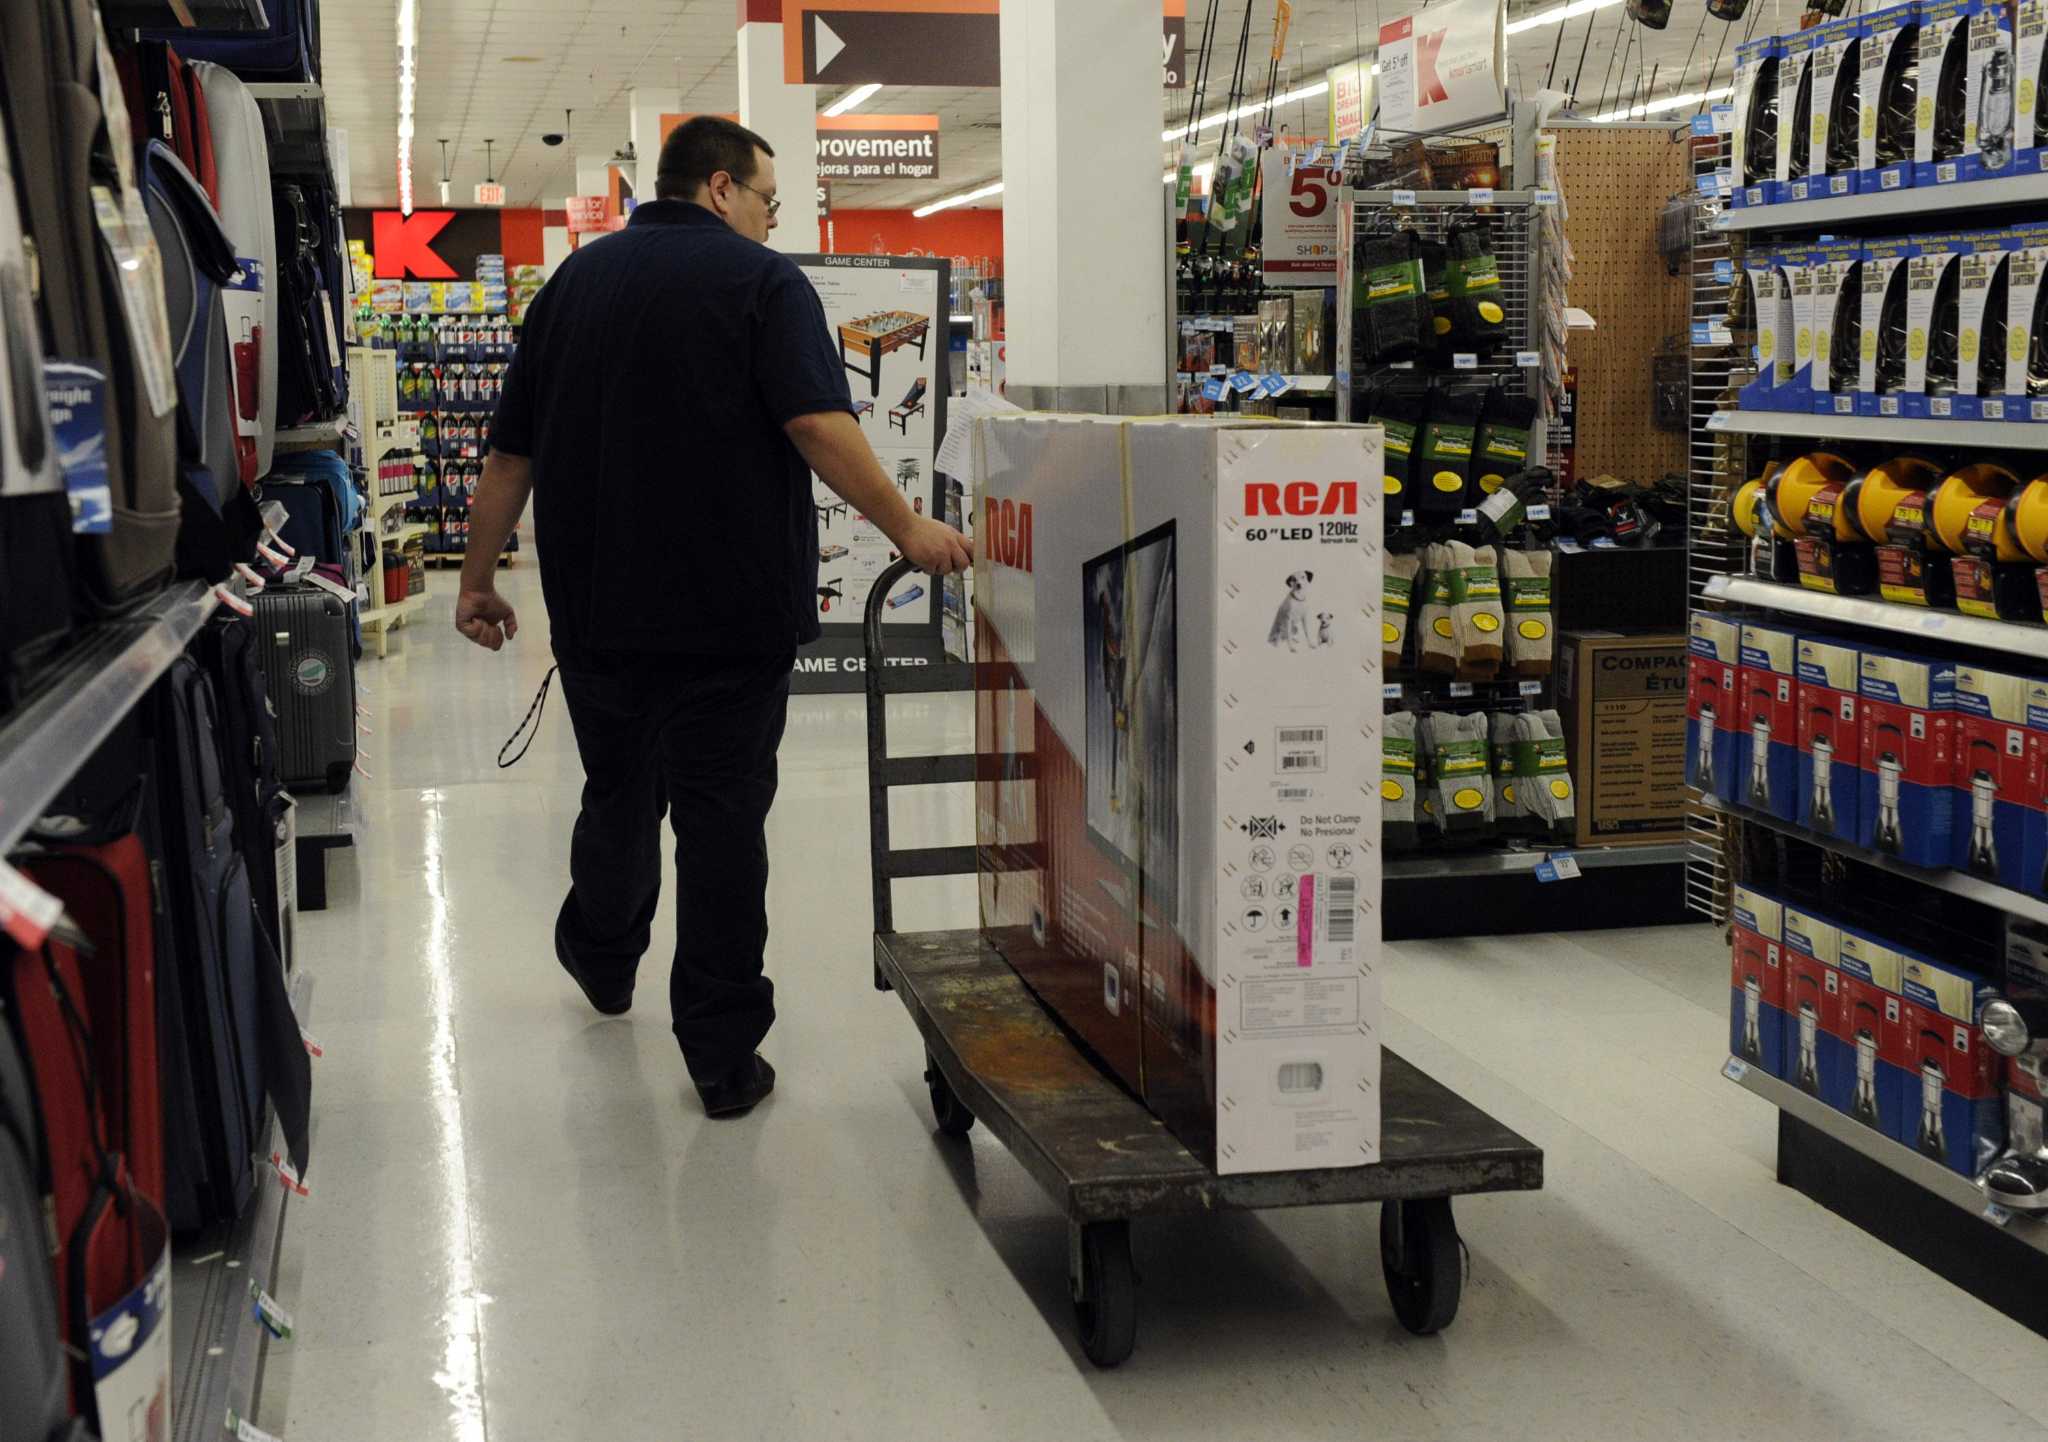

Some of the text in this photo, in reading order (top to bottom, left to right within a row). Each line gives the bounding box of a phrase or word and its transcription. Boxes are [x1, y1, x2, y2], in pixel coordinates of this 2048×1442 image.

[854, 164, 880, 177] para
[884, 163, 895, 175] el
[900, 163, 933, 177] hogar
[373, 211, 459, 278] K
[825, 257, 890, 267] GAME CENTER
[1244, 480, 1358, 516] RCA
[985, 496, 1032, 573] RCA
[1319, 521, 1358, 536] 120Hz
[1301, 814, 1361, 825] Do Not Clamp
[1301, 827, 1356, 837] No Presionar
